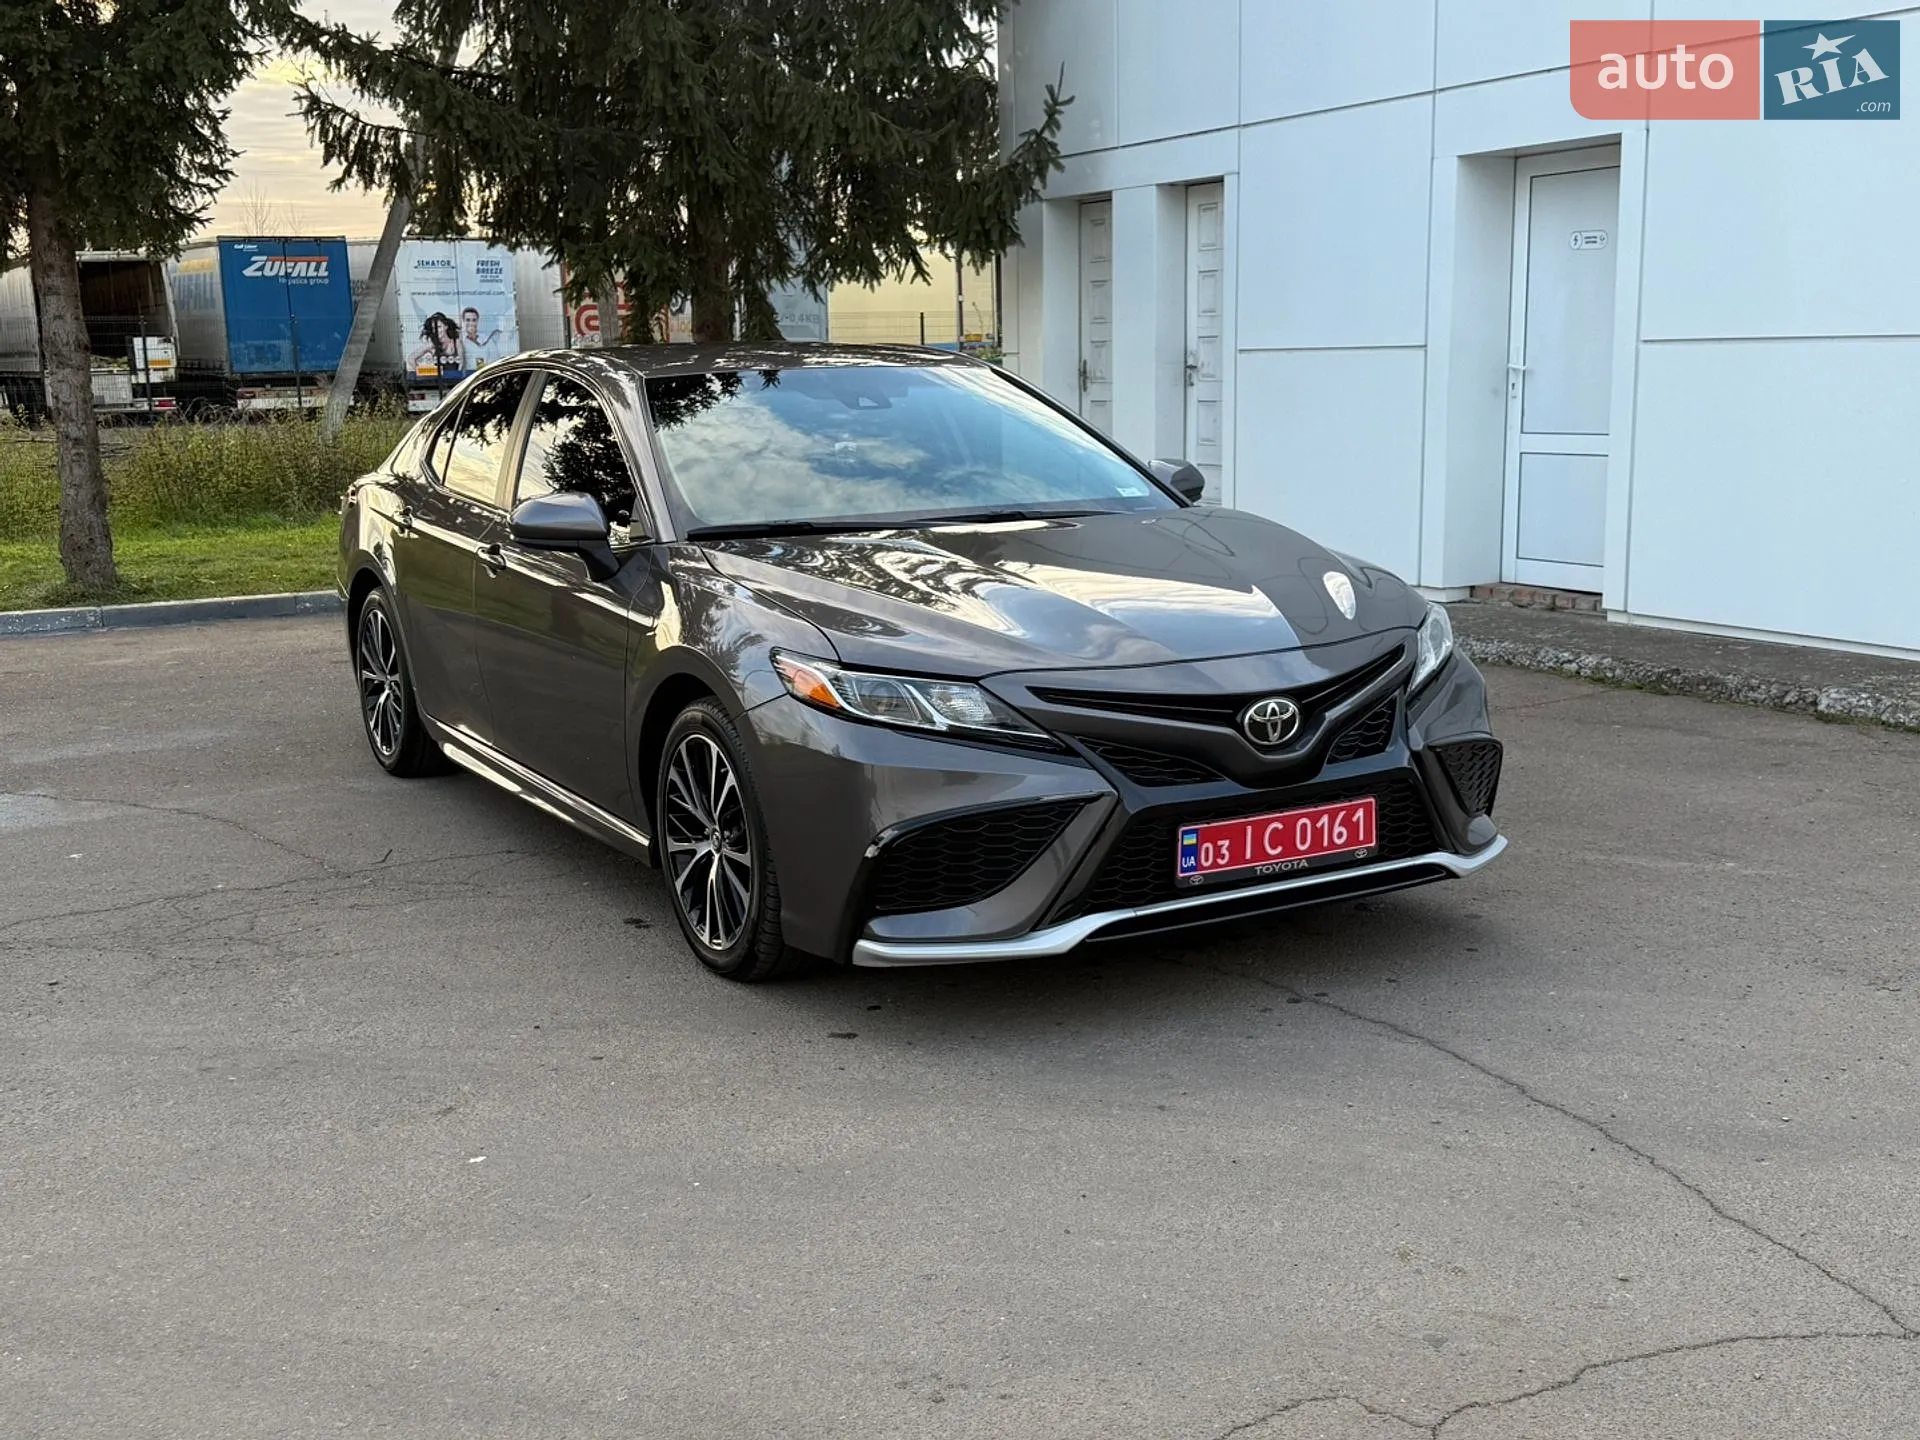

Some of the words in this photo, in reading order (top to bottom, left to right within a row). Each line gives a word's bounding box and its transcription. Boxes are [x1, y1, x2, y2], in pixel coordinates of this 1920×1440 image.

[242, 256, 329, 277] ZUFALL
[1201, 839, 1231, 867] 03
[1245, 822, 1284, 859] IC
[1295, 807, 1365, 851] 0161
[1182, 856, 1196, 868] UA
[1255, 859, 1309, 875] TOYOTA
